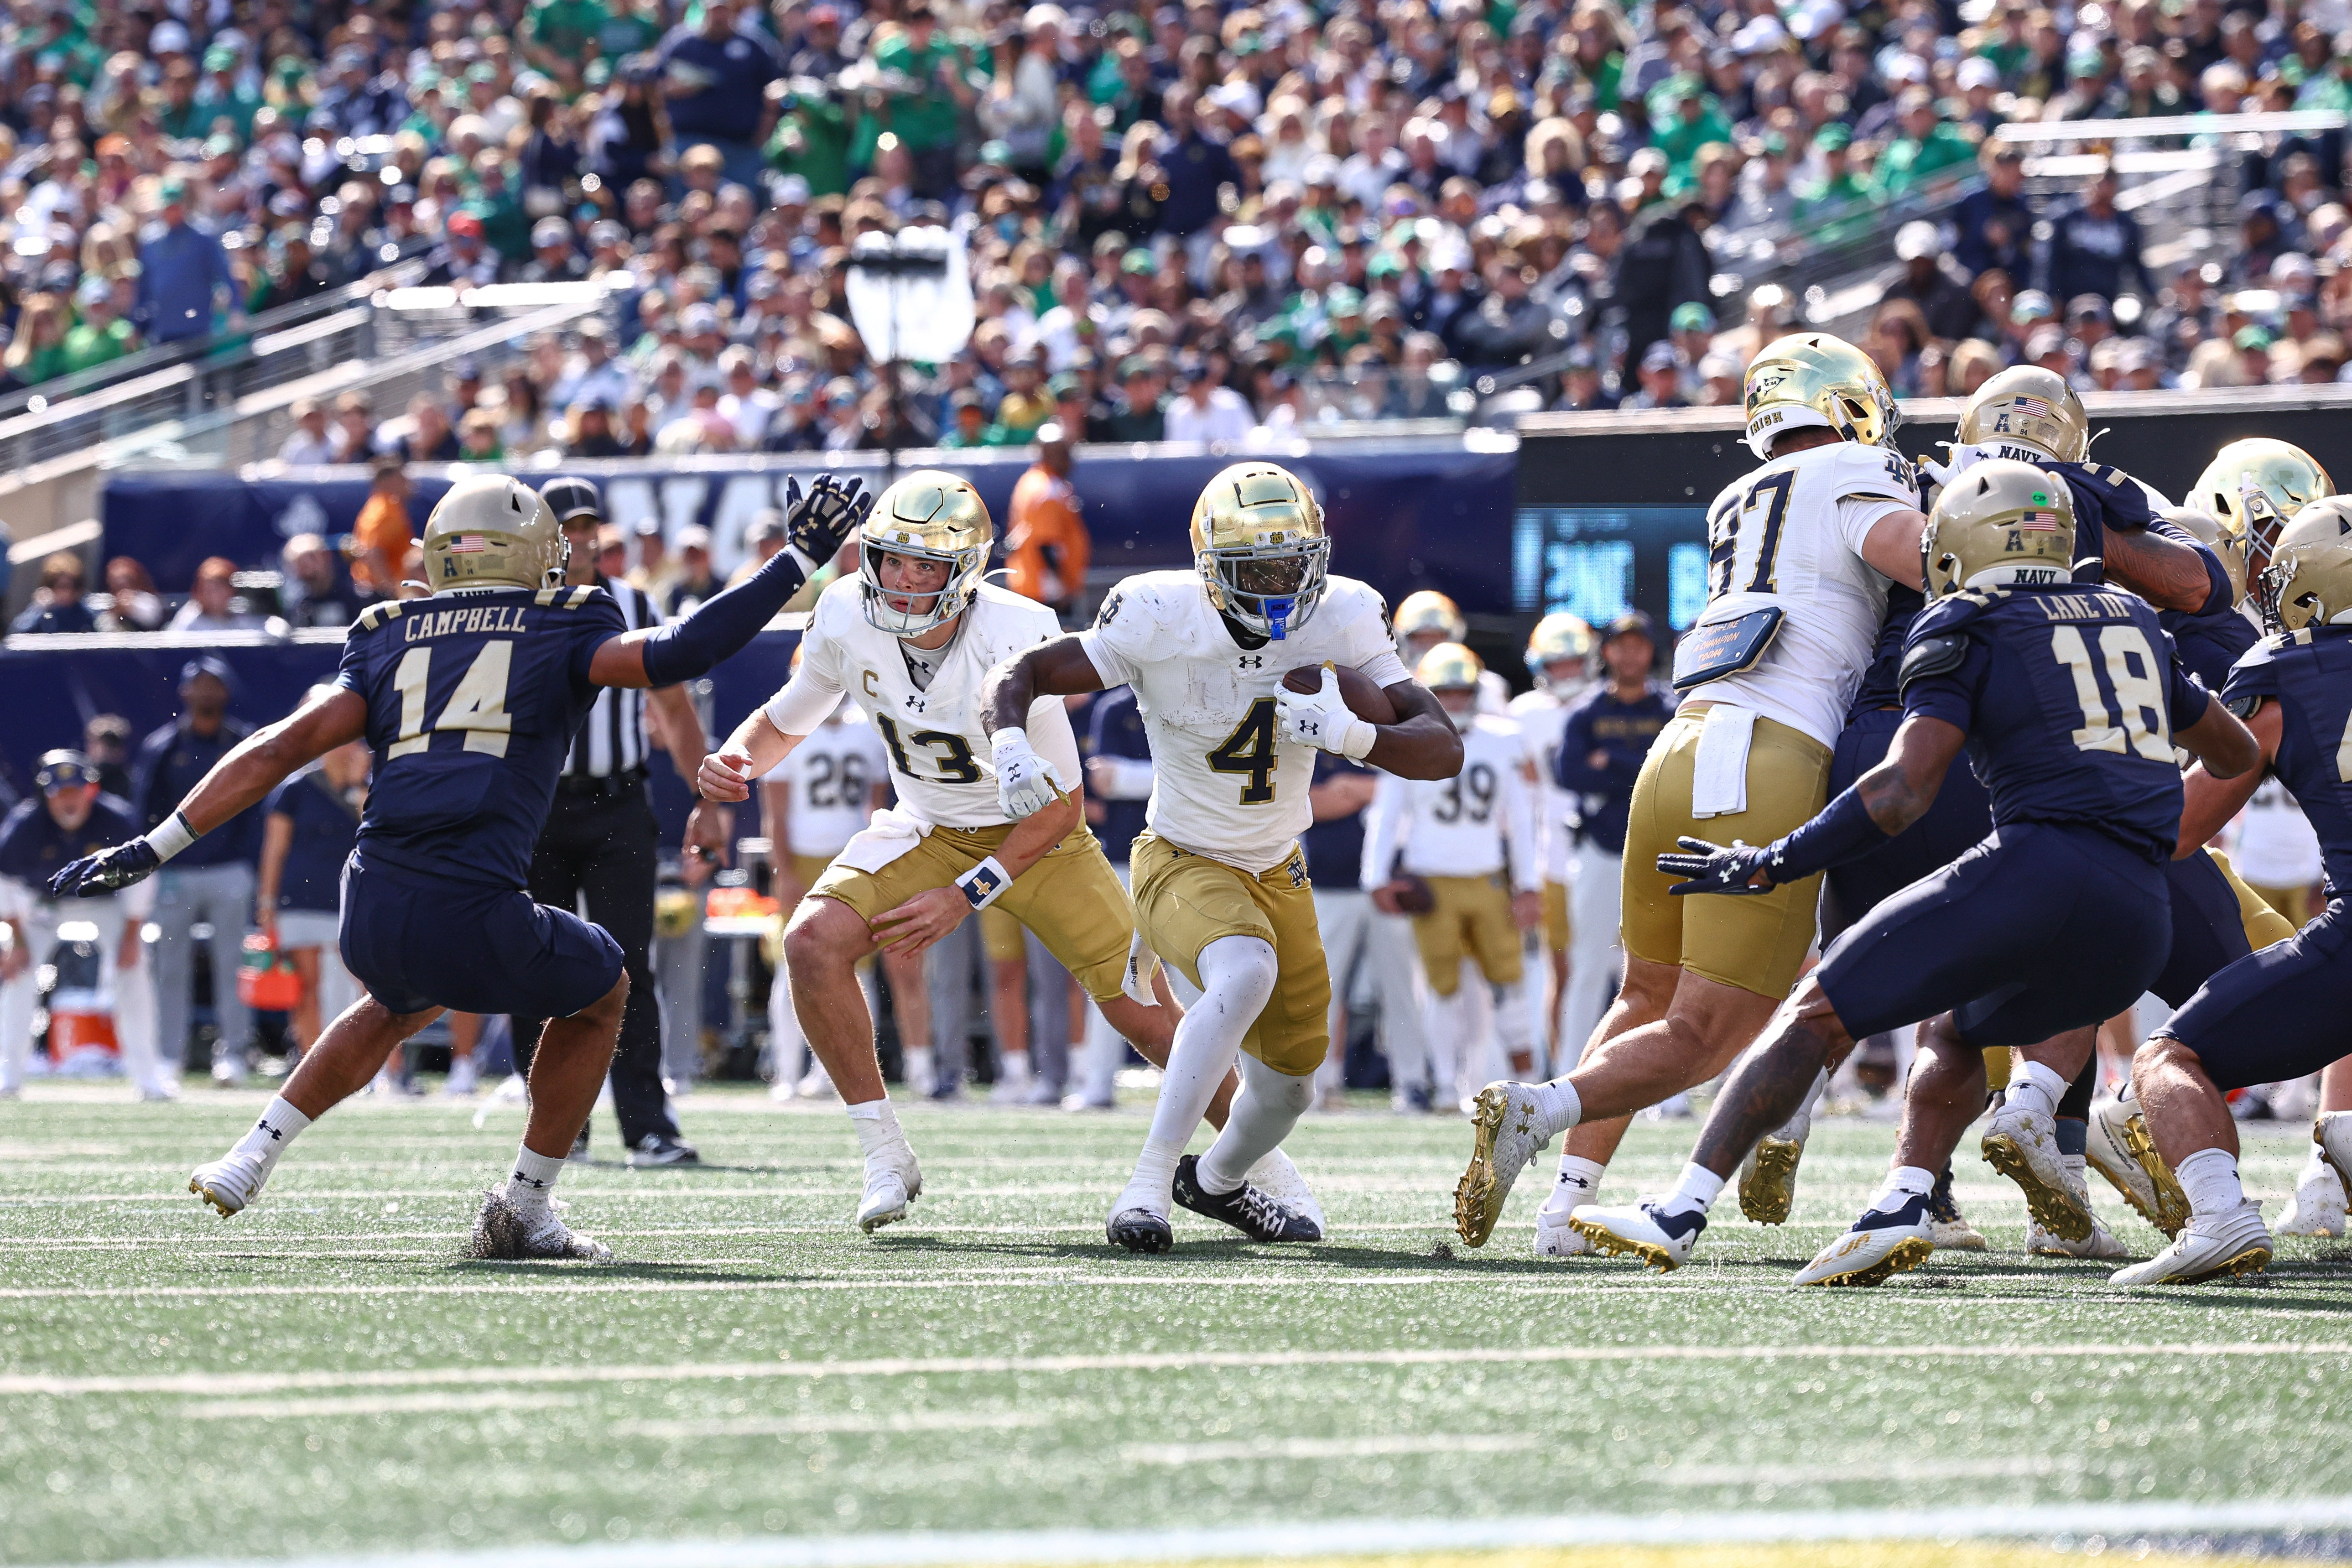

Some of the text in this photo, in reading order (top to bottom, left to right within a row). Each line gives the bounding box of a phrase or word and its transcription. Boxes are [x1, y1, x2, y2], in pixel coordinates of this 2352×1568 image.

[1749, 411, 1783, 437] IRISH
[1998, 445, 2041, 463] NAVY
[2014, 569, 2057, 584] NAVY
[2031, 593, 2130, 620] LANE III
[405, 607, 526, 642] CAMPBELL
[1700, 632, 1741, 651] CHAMPION
[1697, 648, 1725, 662] TODAY
[387, 640, 513, 761] 14
[863, 669, 879, 698] C
[2051, 625, 2176, 763] 18
[877, 712, 983, 784] 13
[1205, 697, 1279, 806] 4
[808, 750, 863, 809] 26
[1432, 764, 1497, 823] 39
[2099, 1114, 2135, 1171] UNDER ARMOUR
